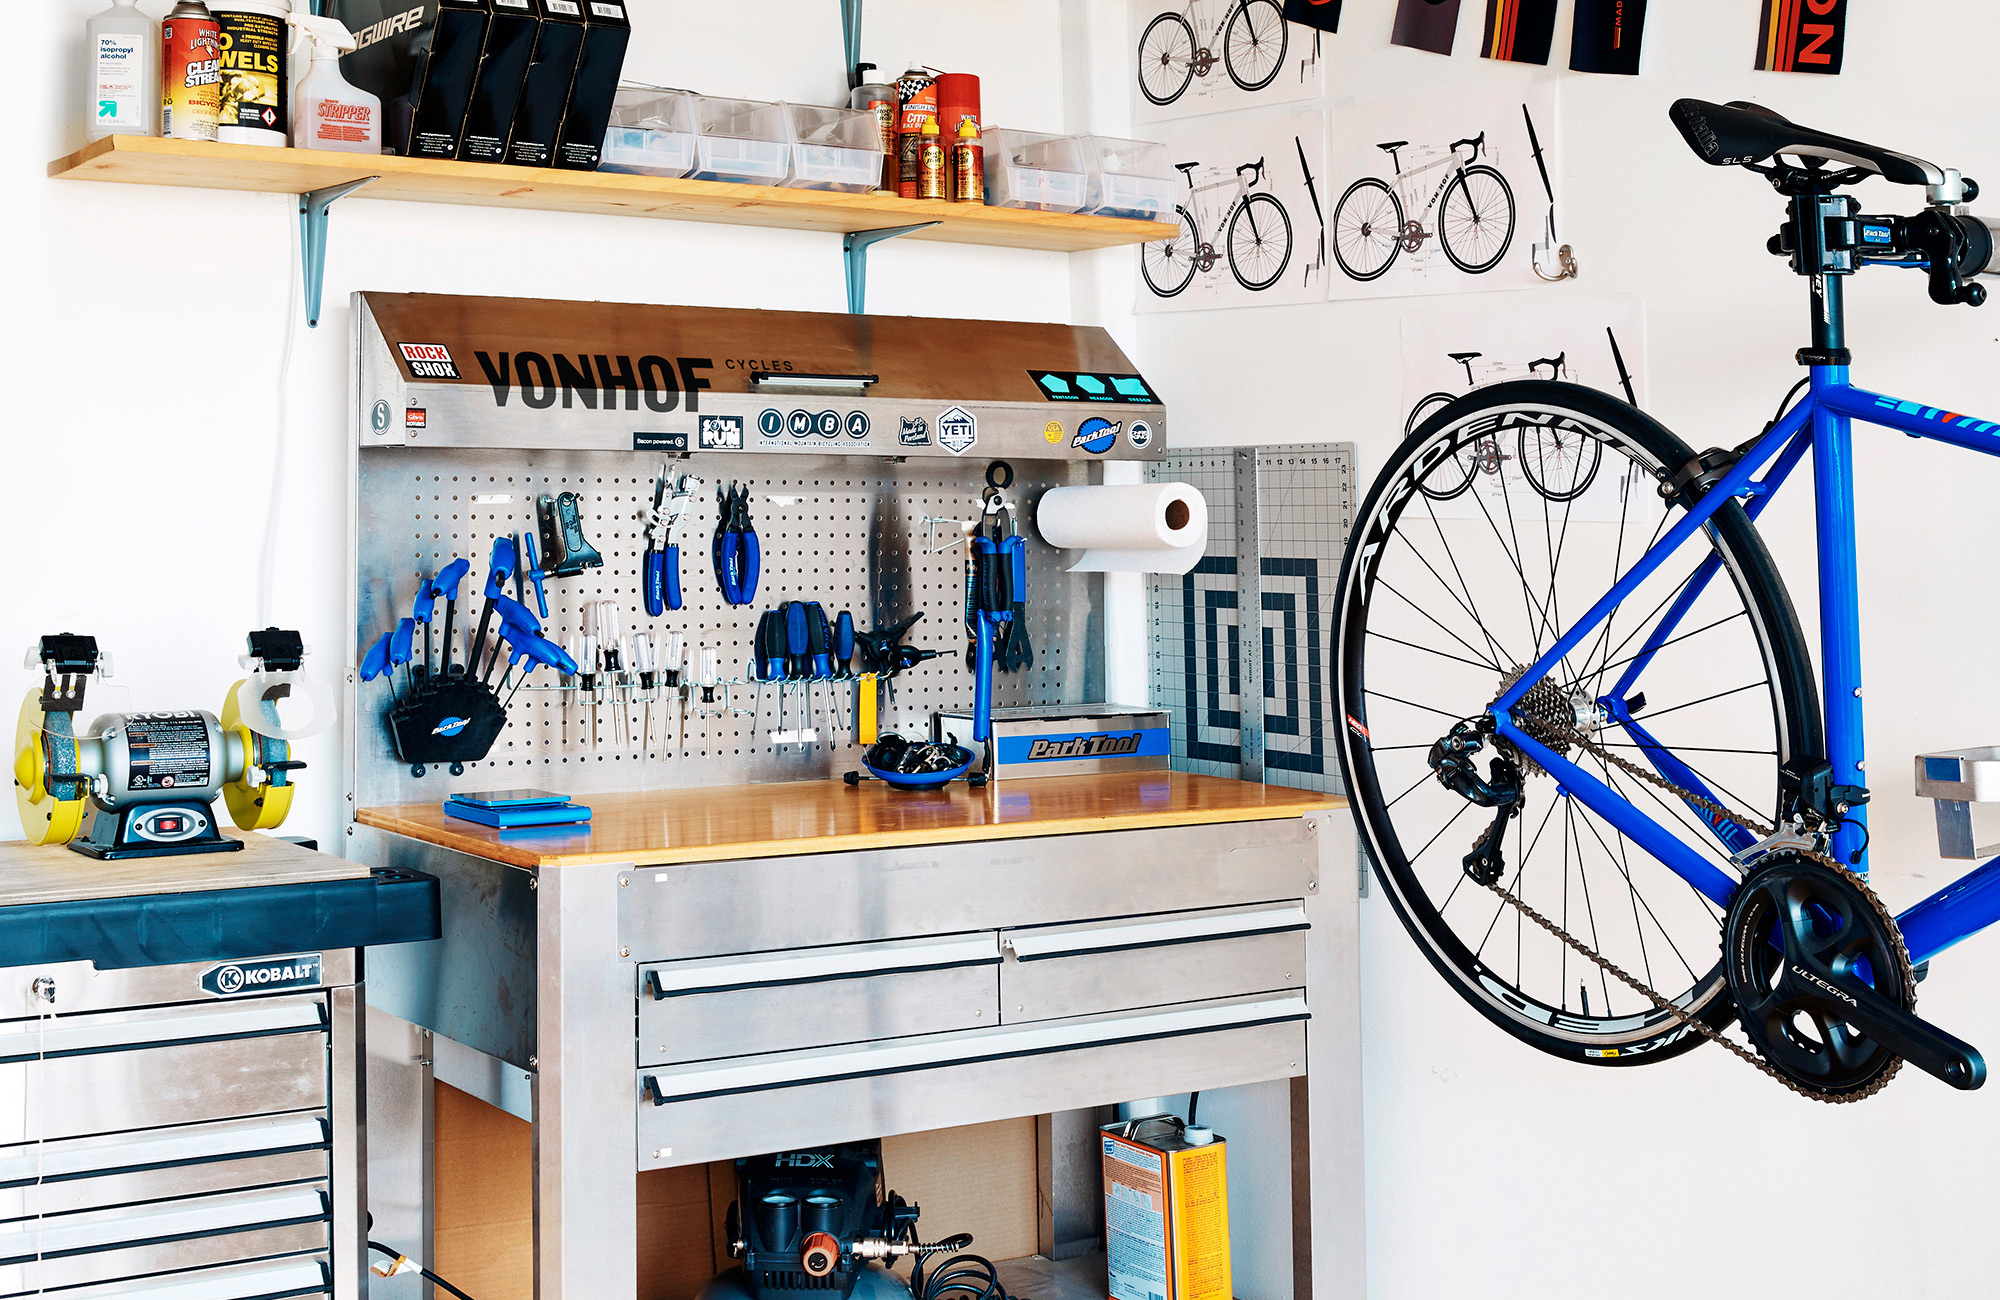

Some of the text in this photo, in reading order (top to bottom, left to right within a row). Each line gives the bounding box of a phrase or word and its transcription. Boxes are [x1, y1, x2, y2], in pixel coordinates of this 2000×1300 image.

[198, 28, 217, 40] WHITE
[318, 102, 371, 121] STRIPPER
[1721, 155, 1753, 165] SLS
[1427, 173, 1450, 209] VON HOF
[403, 346, 448, 360] ROCK
[411, 361, 457, 377] SHOX
[473, 351, 793, 413] VONHOF CYCLES
[941, 425, 972, 436] YETI
[702, 431, 741, 446] RUN
[1341, 465, 1347, 474] 23
[1342, 482, 1348, 492] 22
[1342, 500, 1348, 510] 21
[1343, 518, 1349, 528] 20
[245, 964, 312, 985] KOBALT
[1791, 965, 1858, 1008] ULTEGRA
[774, 1153, 835, 1168] HDX
